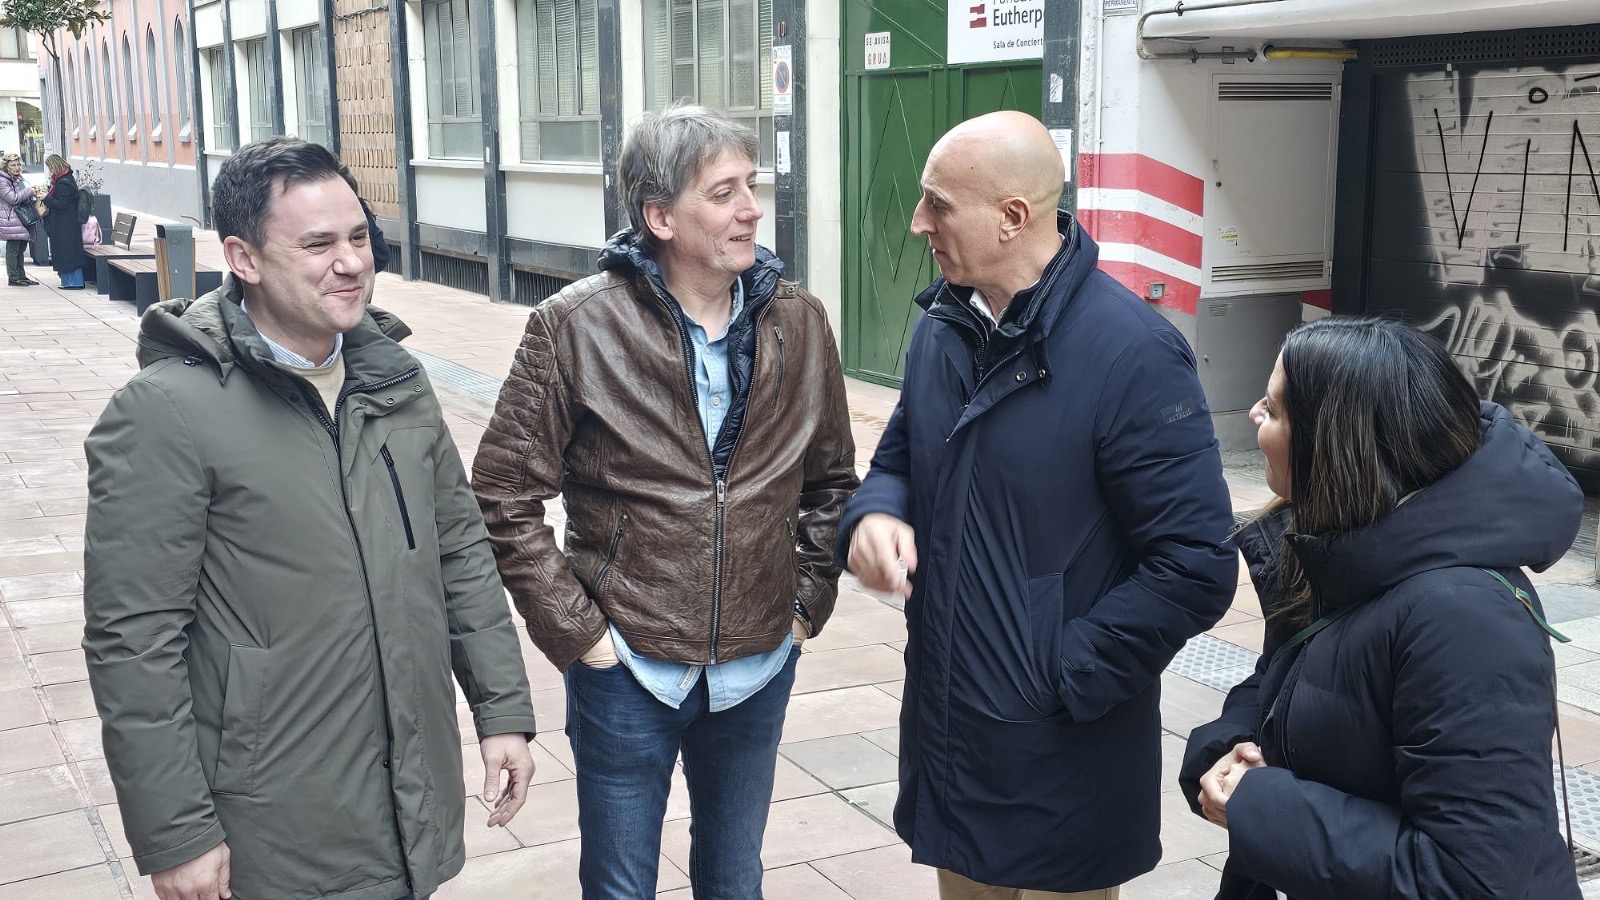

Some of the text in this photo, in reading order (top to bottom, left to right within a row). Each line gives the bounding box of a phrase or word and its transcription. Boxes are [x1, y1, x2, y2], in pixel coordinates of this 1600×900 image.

[993, 40, 1006, 49] Sala
[1007, 39, 1015, 48] de
[868, 52, 887, 65] GRUA
